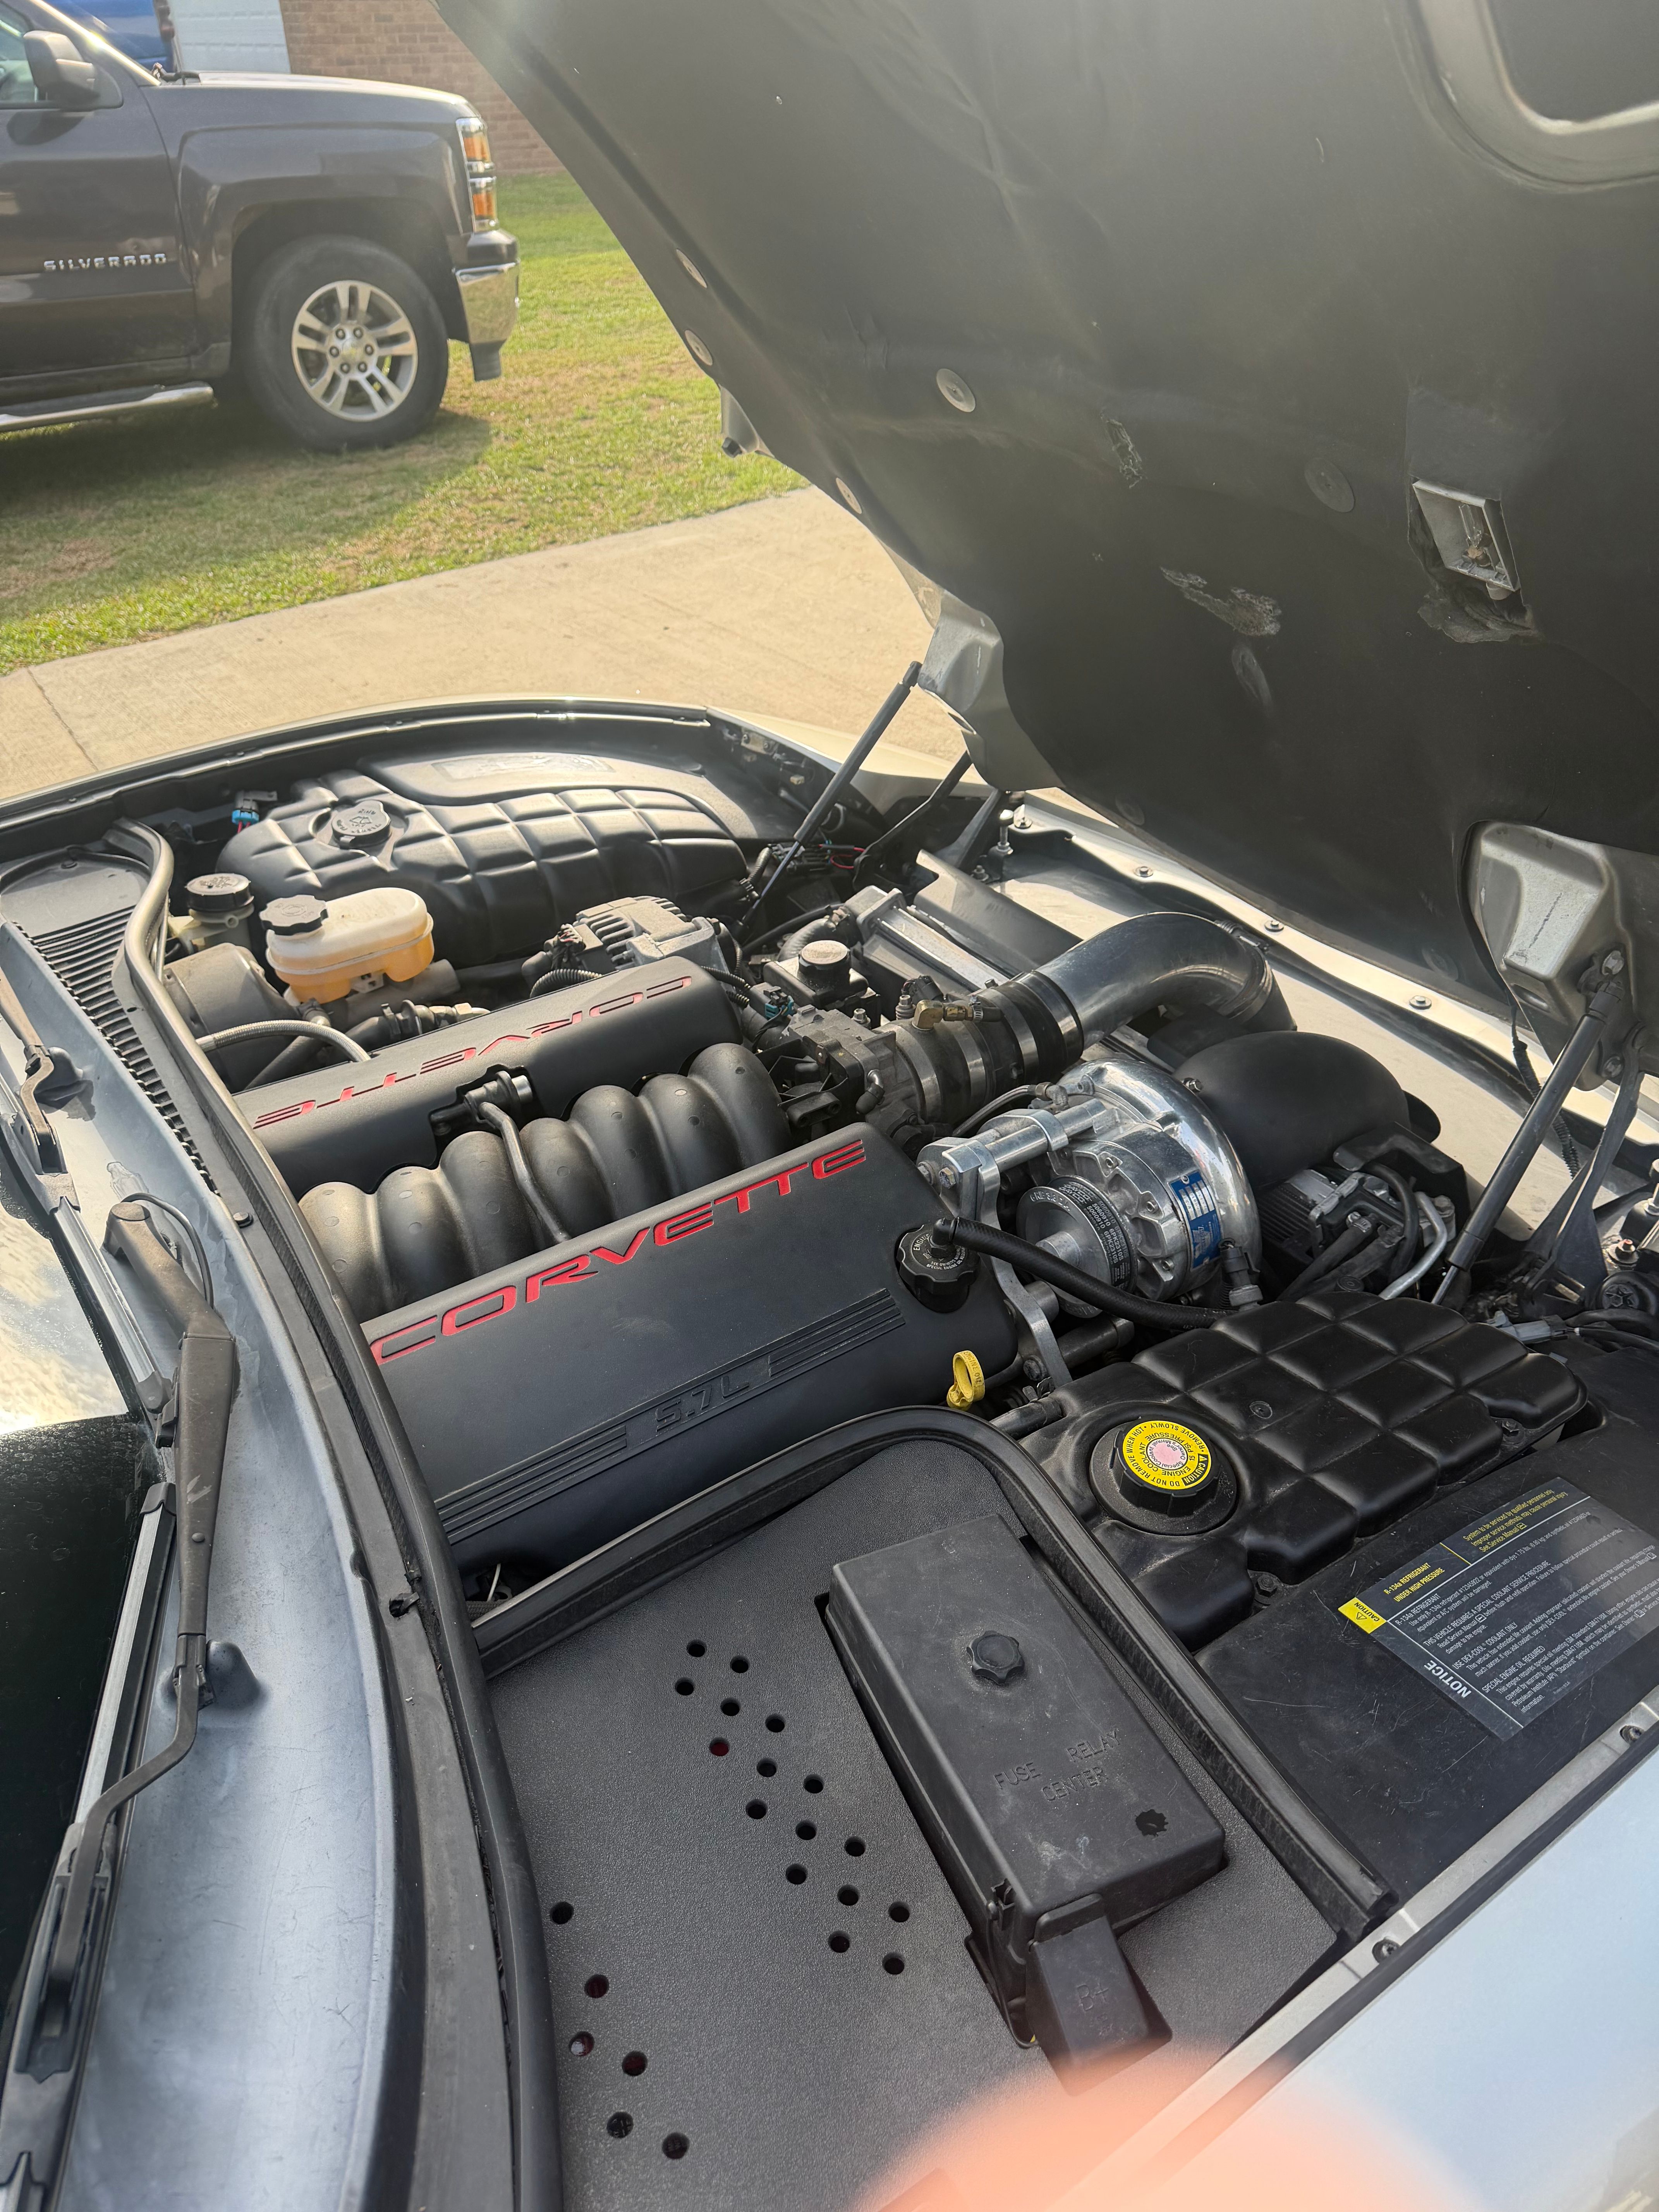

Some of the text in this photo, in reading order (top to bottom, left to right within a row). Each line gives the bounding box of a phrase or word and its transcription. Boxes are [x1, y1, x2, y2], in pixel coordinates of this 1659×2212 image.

[44, 253, 167, 270] SILVERADO
[253, 975, 692, 1129] CORVETTE
[1087, 1206, 1105, 1229] 5060910
[1104, 1231, 1118, 1264] 6PK2310S
[1092, 1204, 1111, 1226] 5060910
[1109, 1228, 1124, 1261] 6PK2310S
[370, 1139, 866, 1365] CORVETTE
[964, 1352, 979, 1371] ENGINE
[655, 1376, 750, 1432] 5.7L
[1127, 1436, 1135, 1453] WHEN
[1132, 1426, 1144, 1437] HOT
[1145, 1432, 1185, 1443] PRESSURE
[1180, 1428, 1206, 1449] REMOVE
[1183, 1443, 1193, 1453] PSI
[1128, 1455, 1151, 1479] REMOVE
[1139, 1442, 1190, 1476] ENGINE COOLANT
[1149, 1446, 1161, 1466] Coolant
[1172, 1442, 1186, 1460] Owner's
[1184, 1462, 1206, 1484] CAUTION
[1462, 1530, 1482, 1541] System
[1470, 1534, 1493, 1546] Improper
[1487, 1535, 1506, 1547] Service
[1501, 1526, 1520, 1537] Manual
[1383, 1562, 1431, 1594] R-134a REFRIGERANT
[1393, 1567, 1445, 1602] UNDER HIGH PRESSURE
[1424, 1604, 1441, 1615] R-134a
[1439, 1590, 1460, 1606] refrigerant
[1483, 1563, 1503, 1577] equivalent
[1353, 1602, 1380, 1622] CAUTION
[1395, 1593, 1441, 1625] R-134a REFRIGERANT
[1416, 1616, 1438, 1632] equivalent
[1447, 1600, 1463, 1611] system
[1471, 1580, 1492, 1594] damaged.
[1423, 1637, 1436, 1646] THIS
[1433, 1625, 1454, 1640] VEHICLE
[1451, 1611, 1474, 1628] REQUIRES
[1474, 1597, 1494, 1612] SPECIAL
[1491, 1585, 1513, 1600] COOLANT
[1509, 1574, 1529, 1588] SERVICE
[1525, 1560, 1551, 1577] PROCEDURE
[1436, 1638, 1450, 1648] Read
[1446, 1630, 1464, 1641] Service
[1461, 1619, 1478, 1631] Manual
[1482, 1606, 1498, 1616] before
[1494, 1599, 1507, 1608] flush
[1444, 1641, 1463, 1654] damage
[1472, 1624, 1488, 1635] engine.
[1475, 1666, 1488, 1676] much
[1503, 1650, 1512, 1658] you
[1510, 1643, 1520, 1652] add
[1566, 1598, 1584, 1611] extended
[1475, 1653, 1491, 1664] vehicle
[1496, 1635, 1515, 1650] extended
[1532, 1613, 1549, 1624] Adding
[1452, 1660, 1465, 1669] USE
[1485, 1629, 1508, 1646] COOLANT
[1504, 1622, 1519, 1632] ONLY
[1496, 1686, 1508, 1694] This
[1505, 1676, 1521, 1688] engine
[1518, 1665, 1536, 1678] requires
[1534, 1655, 1549, 1667] special
[1551, 1642, 1570, 1654] meeting
[1571, 1625, 1590, 1638] Standard
[1422, 1660, 1473, 1698] NOTICE
[1481, 1645, 1546, 1693] SPECIAL ENGINE OIL REQUIRED
[1504, 1686, 1522, 1700] covered
[1525, 1671, 1546, 1685] warranty.
[1549, 1654, 1568, 1667] meeting
[1583, 1632, 1596, 1642] which
[1511, 1690, 1534, 1706] Petroleum
[1530, 1679, 1549, 1692] Institute
[1545, 1671, 1559, 1682] (API)
[1575, 1647, 1591, 1659] symbol
[1519, 1695, 1545, 1713] information.
[994, 1729, 1123, 1790] FUSE RELAY
[1042, 1765, 1106, 1802] CENTER
